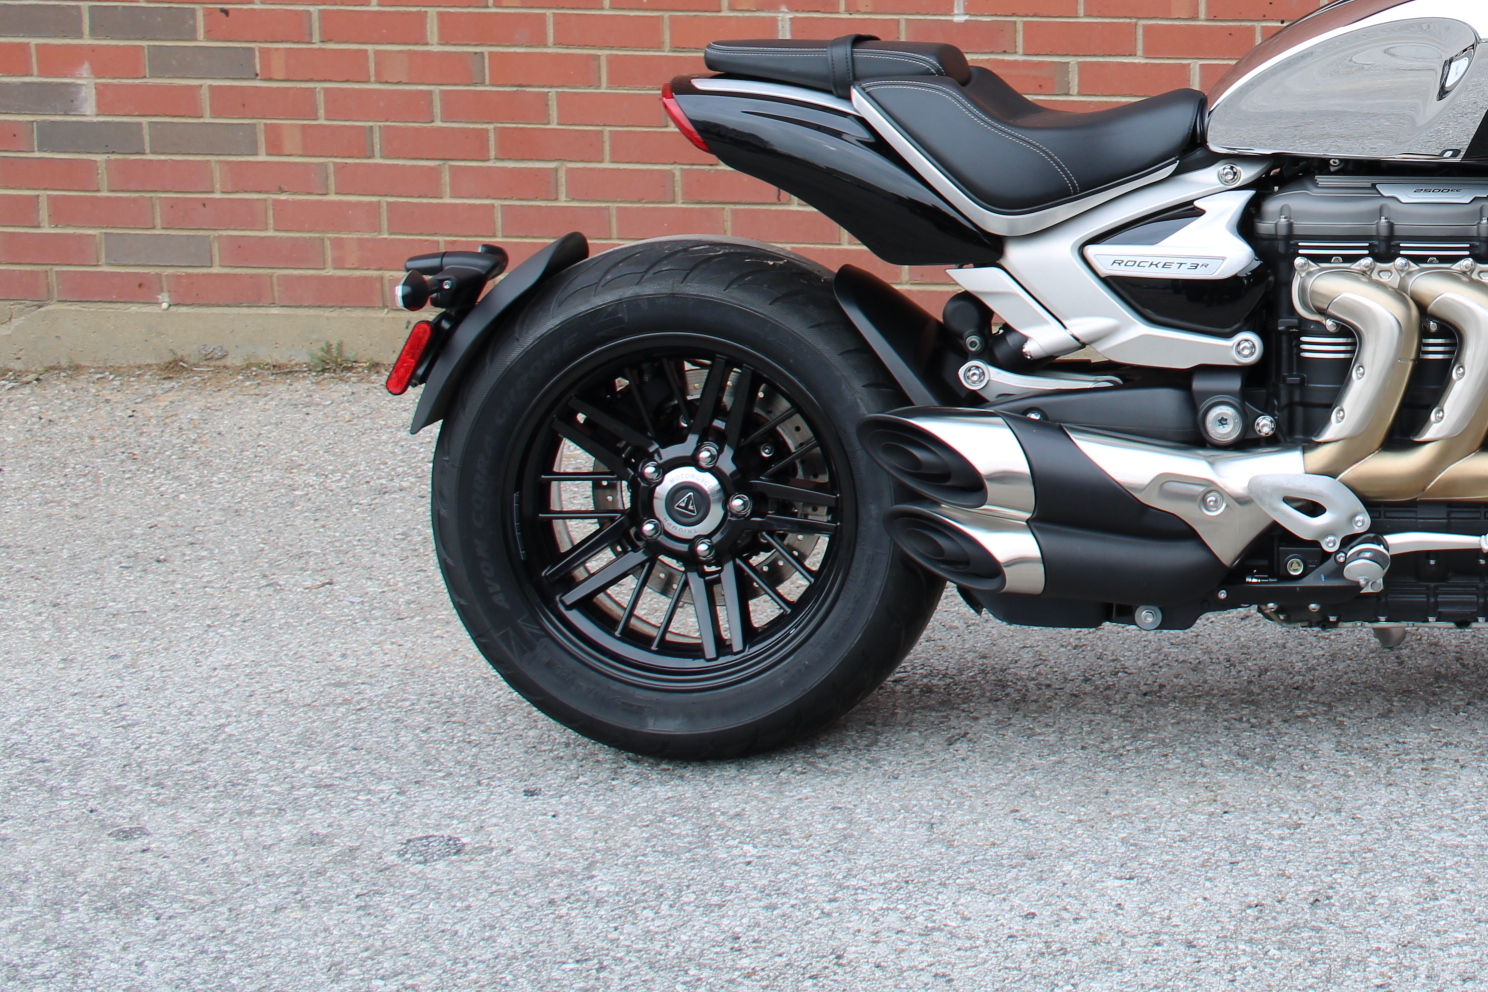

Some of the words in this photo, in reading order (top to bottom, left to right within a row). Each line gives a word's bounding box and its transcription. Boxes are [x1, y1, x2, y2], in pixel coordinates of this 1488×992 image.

[1111, 259, 1187, 270] ROCKET
[495, 332, 579, 423] CHROME
[471, 434, 496, 529] COBRA
[662, 517, 698, 534] TRIUMPH
[475, 538, 510, 610] AVON
